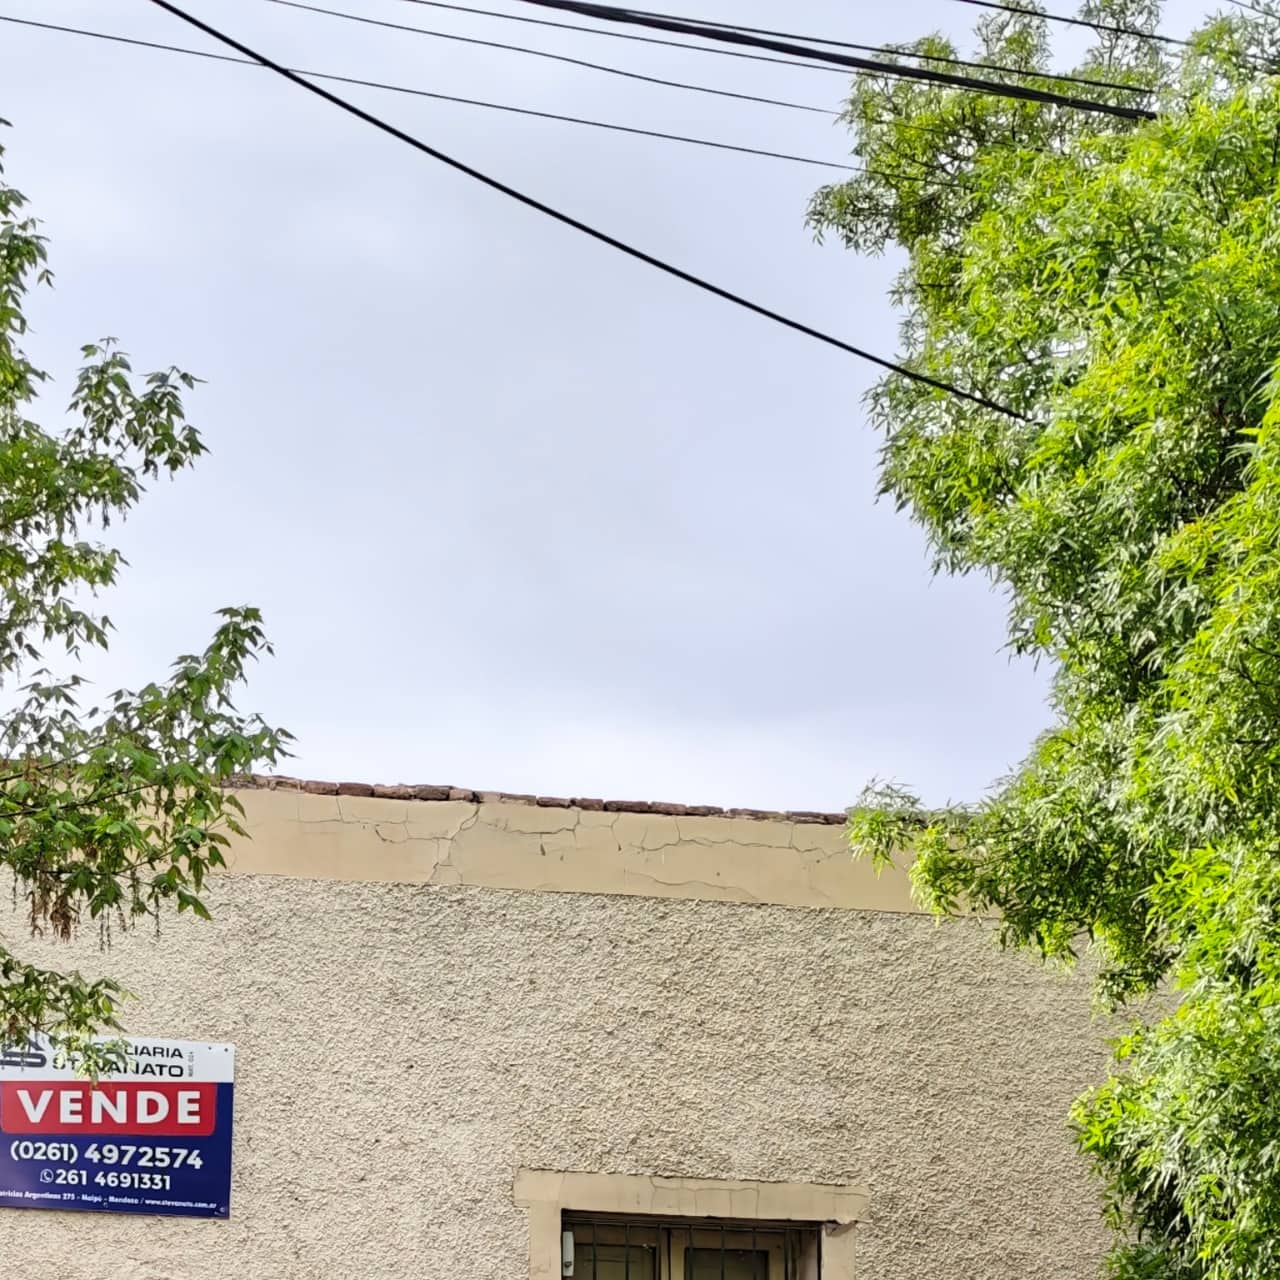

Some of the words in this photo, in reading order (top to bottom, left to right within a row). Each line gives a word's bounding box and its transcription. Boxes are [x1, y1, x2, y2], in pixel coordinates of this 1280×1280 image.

[17, 1090, 201, 1124] VENDE
[10, 1140, 78, 1164] (0261)
[84, 1143, 203, 1170] 4972574
[55, 1169, 88, 1185] 261
[94, 1171, 171, 1190] 4691331
